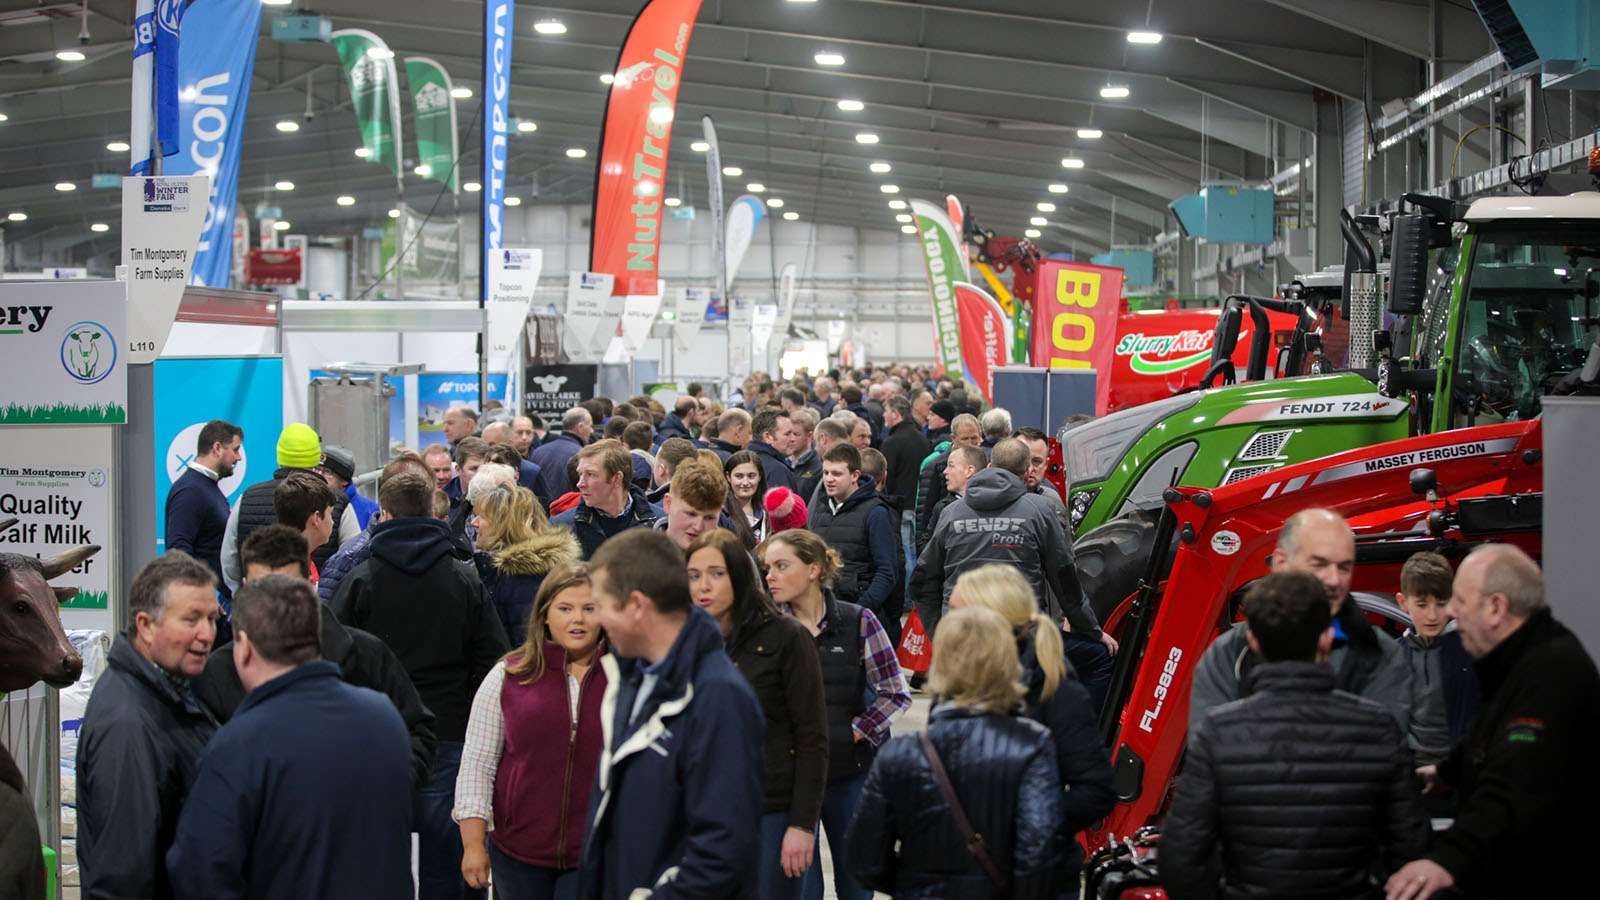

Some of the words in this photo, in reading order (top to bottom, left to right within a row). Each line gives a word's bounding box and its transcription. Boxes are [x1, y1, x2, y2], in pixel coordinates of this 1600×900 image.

[156, 193, 175, 201] FAIR
[130, 248, 143, 260] Tim
[144, 248, 187, 263] Montgomery
[136, 267, 153, 280] Farm
[154, 266, 184, 282] Supplies
[499, 282, 522, 291] Topcon
[493, 294, 529, 304] Positioning
[1116, 330, 1215, 357] SlurryKat
[546, 391, 581, 400] CLARKE
[1280, 402, 1335, 414] FENDT
[1342, 401, 1371, 412] 724
[1365, 454, 1414, 472] MASSEY
[1419, 443, 1485, 462] FERGUSON
[0, 468, 19, 476] Tim
[22, 468, 86, 478] Montgomery
[37, 480, 69, 488] Supplies
[0, 493, 83, 520] Quality
[953, 517, 1026, 534] FENDT
[45, 524, 91, 544] Milk
[992, 533, 1024, 545] Profi
